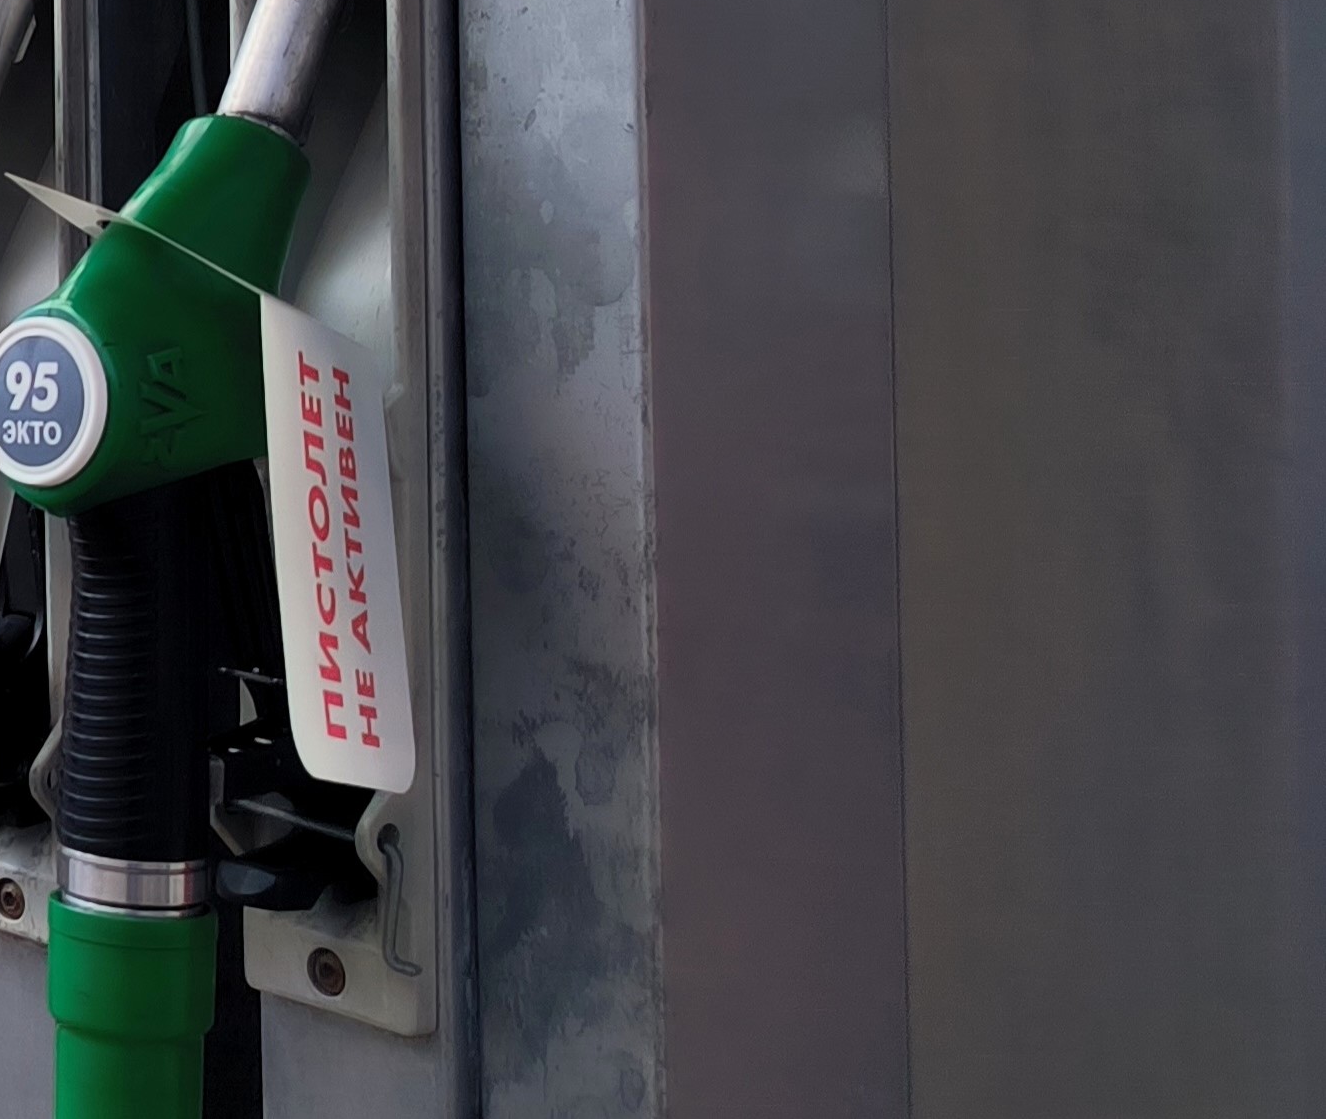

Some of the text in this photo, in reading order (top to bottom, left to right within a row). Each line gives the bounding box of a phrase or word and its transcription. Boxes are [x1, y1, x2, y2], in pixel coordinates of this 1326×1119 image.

[2, 418, 63, 447] ЭКТО
[5, 360, 59, 413] 95
[298, 350, 348, 740] ПИСТОЛЕТ
[332, 365, 381, 749] НЕ АКТИВЕН
